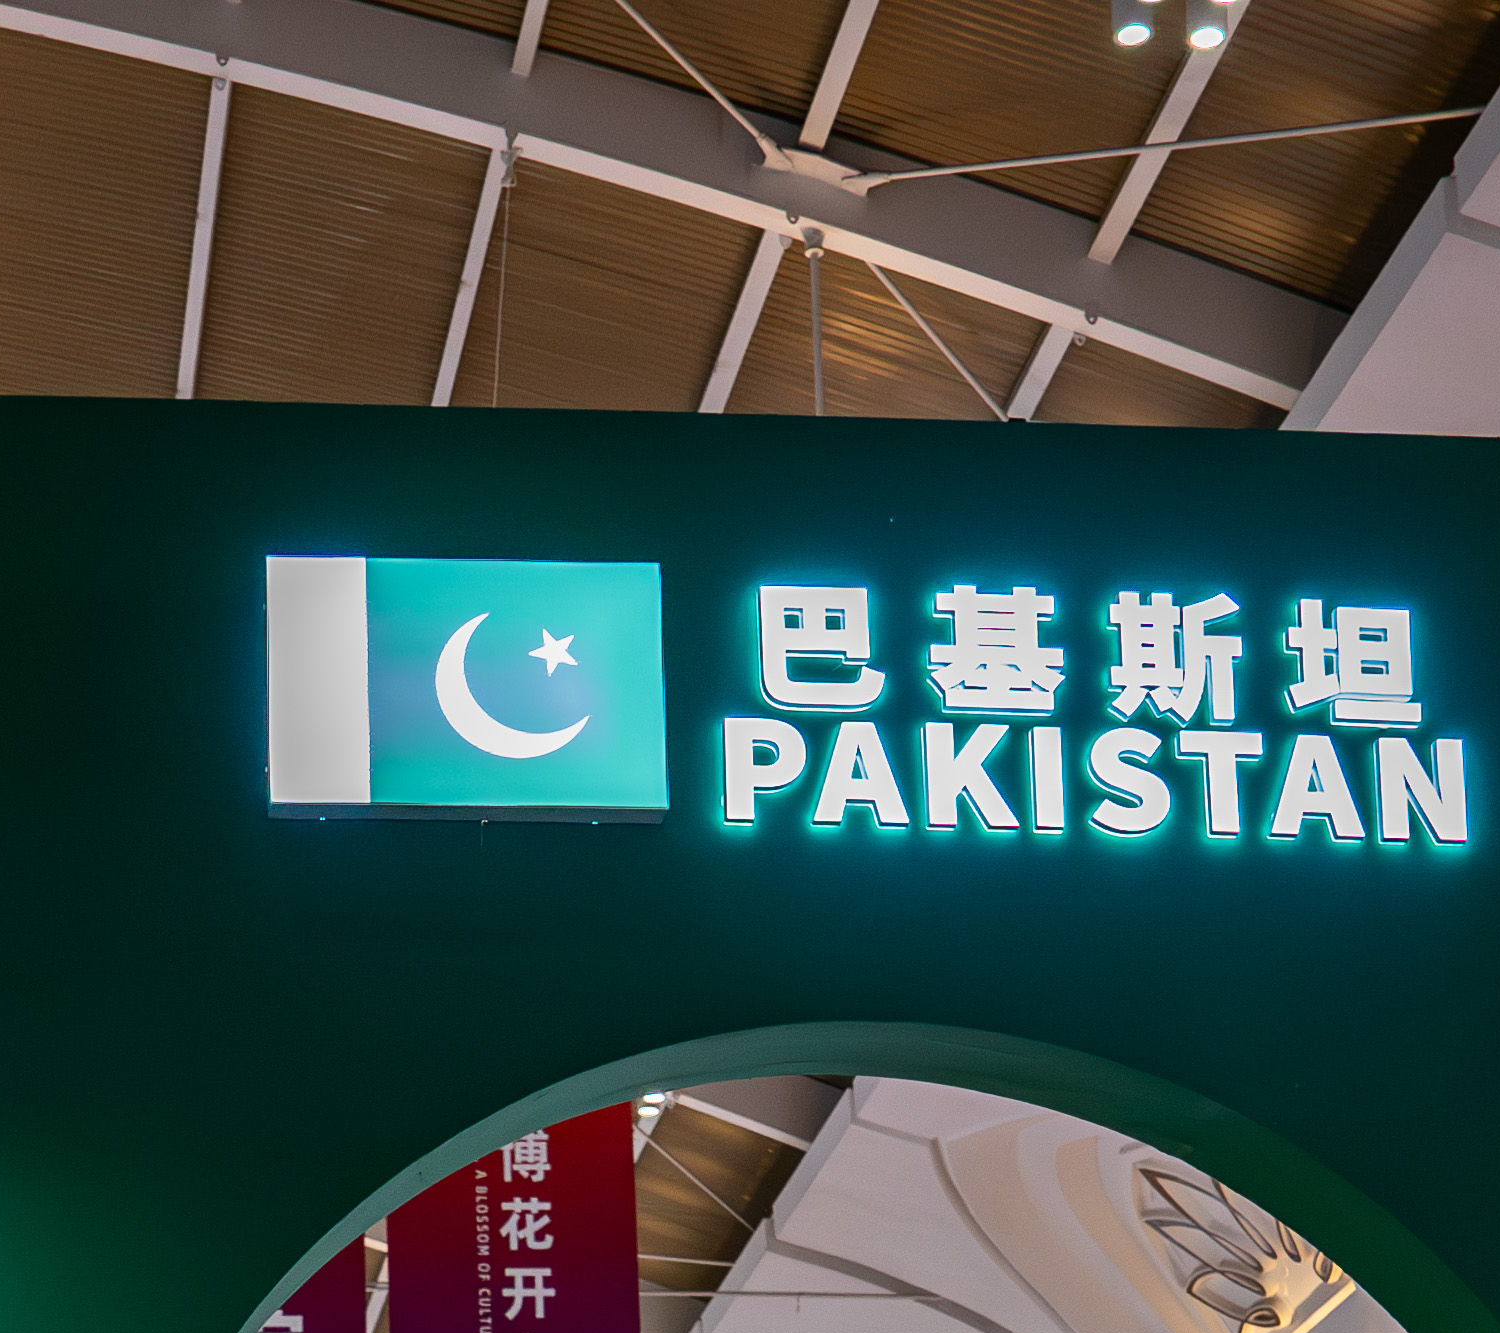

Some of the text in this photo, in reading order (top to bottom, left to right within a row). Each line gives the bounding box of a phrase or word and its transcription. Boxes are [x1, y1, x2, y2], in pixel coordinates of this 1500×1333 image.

[758, 584, 1422, 728] 巴基斯坦
[722, 716, 1470, 844] PAKISTAN
[475, 1185, 490, 1256] BLOSSOM
[477, 1262, 492, 1282] OF
